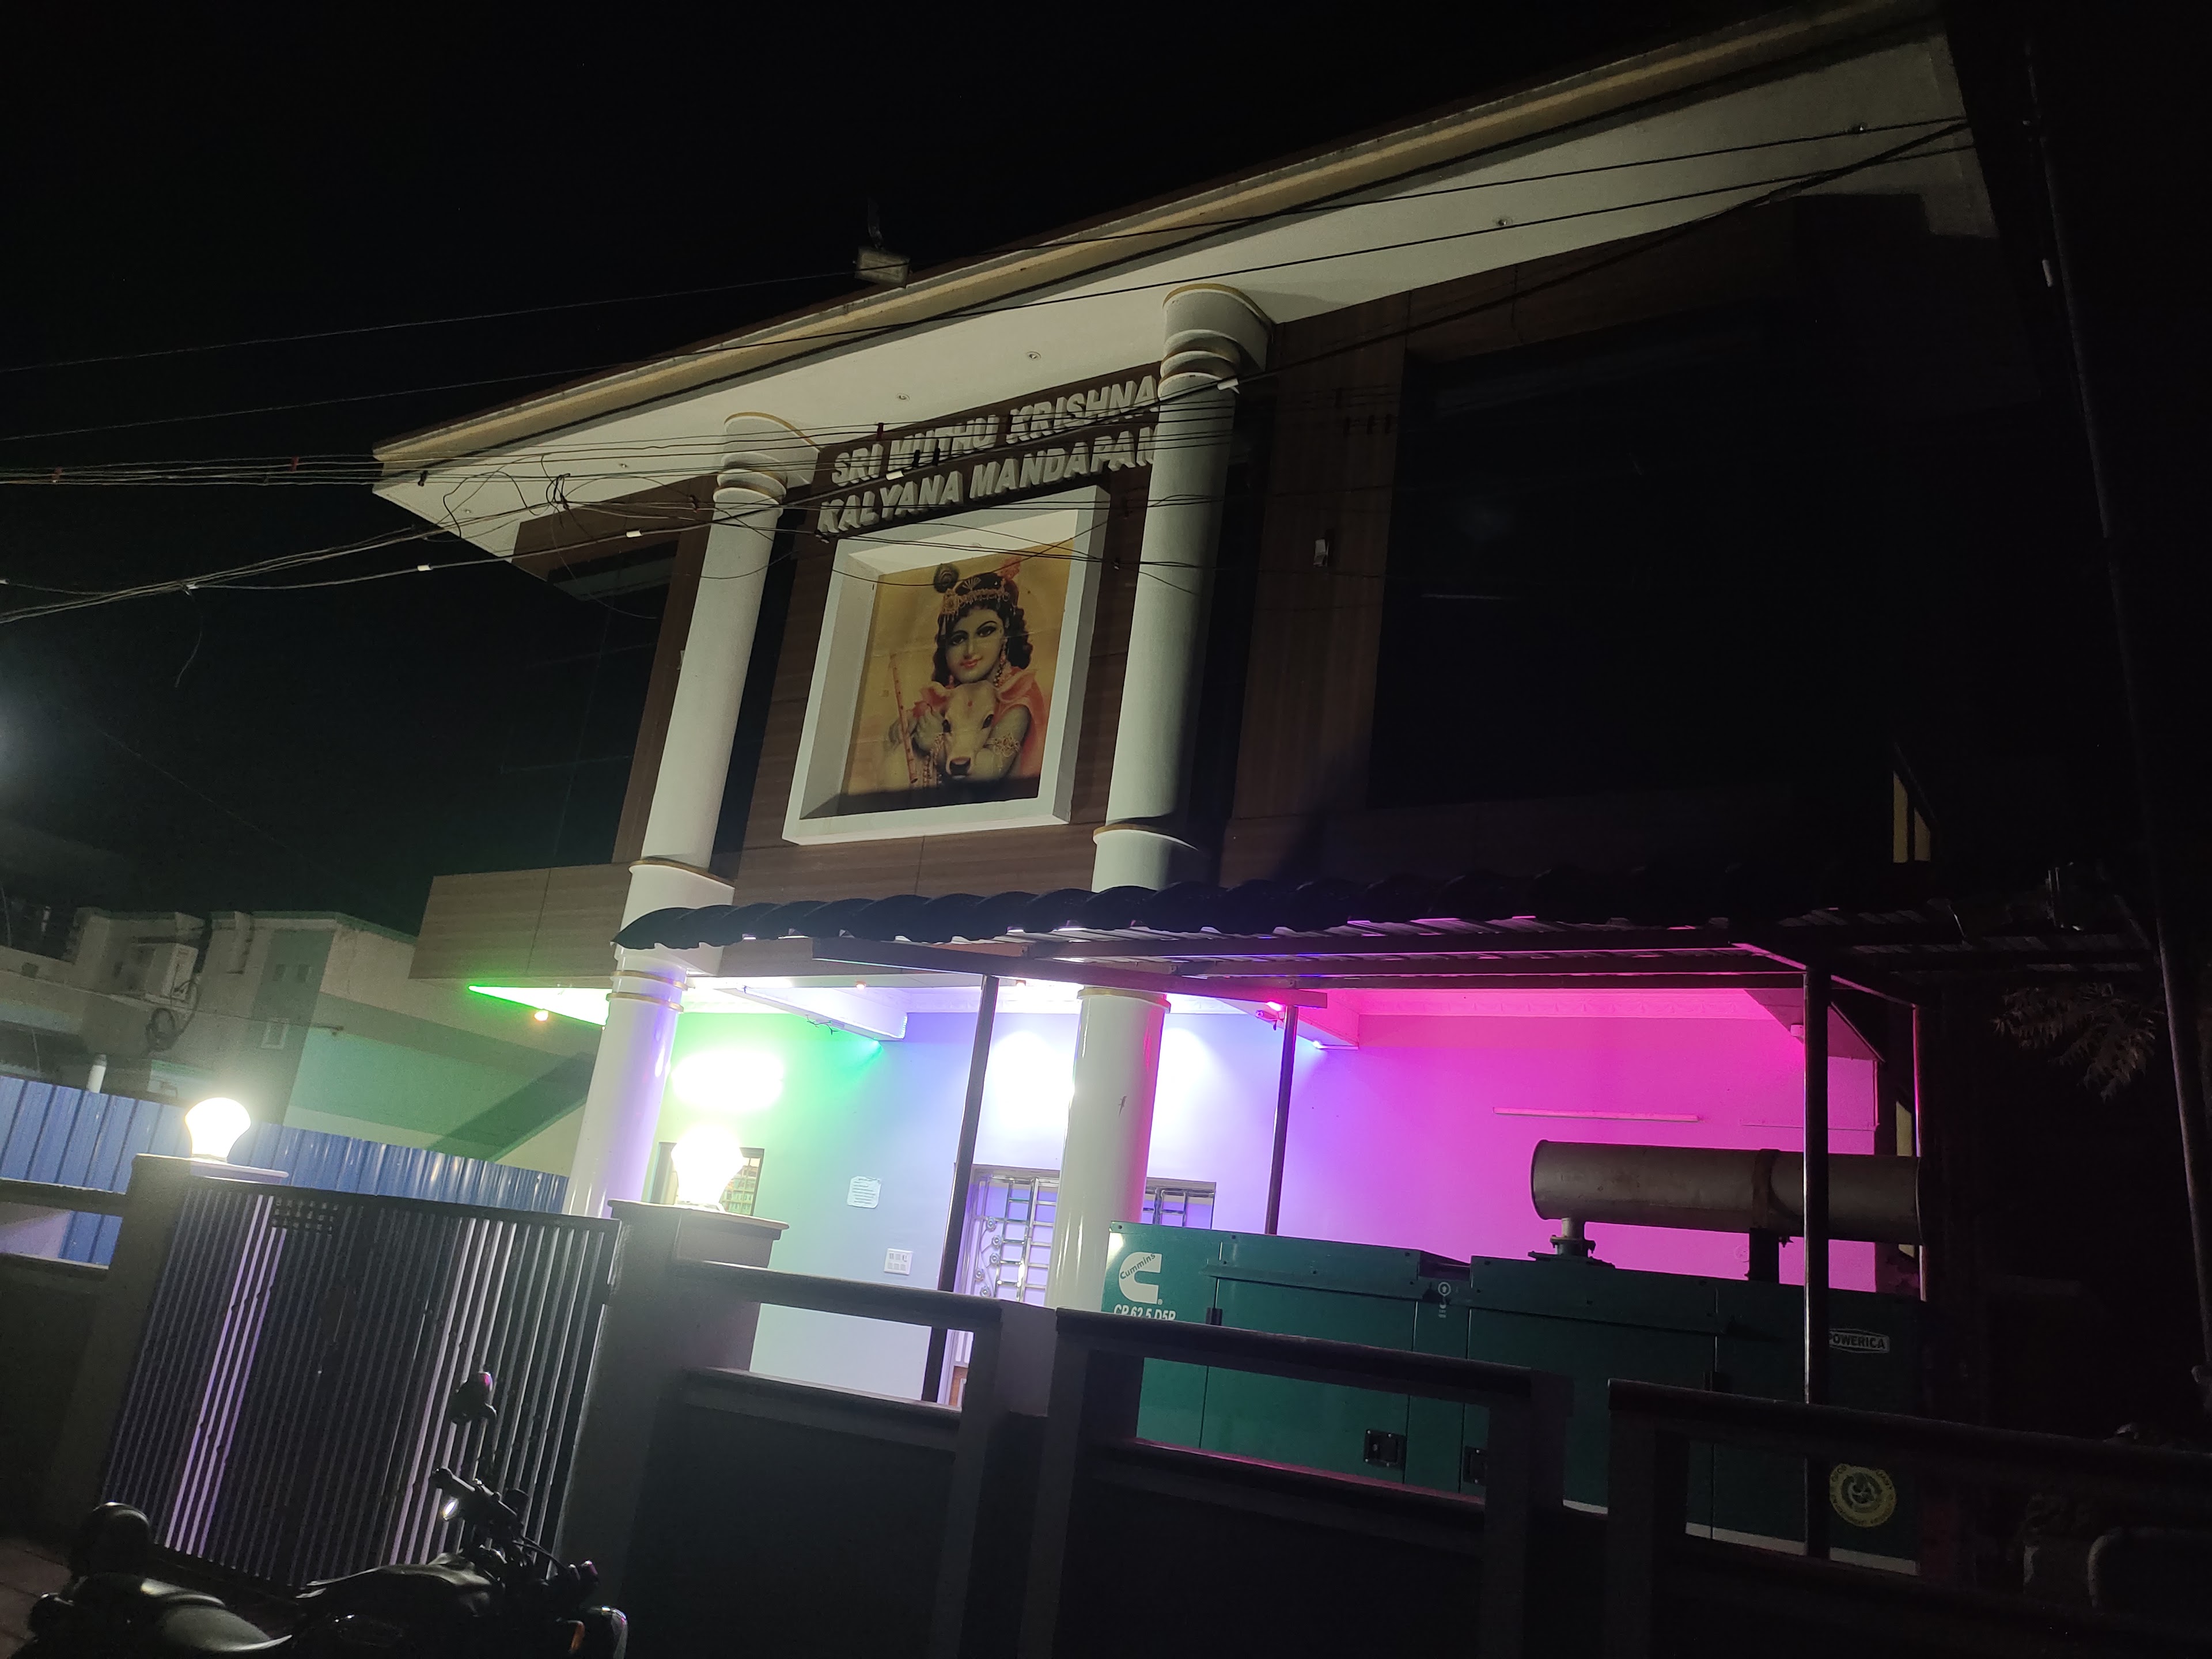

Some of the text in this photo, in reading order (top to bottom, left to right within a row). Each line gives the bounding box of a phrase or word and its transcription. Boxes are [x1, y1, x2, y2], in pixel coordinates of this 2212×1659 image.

[831, 375, 1160, 487] SRI MUTHU KRISHNA
[817, 471, 964, 533] KALYANA
[1119, 1253, 1156, 1279] Cummins
[1130, 1306, 1152, 1319] 625
